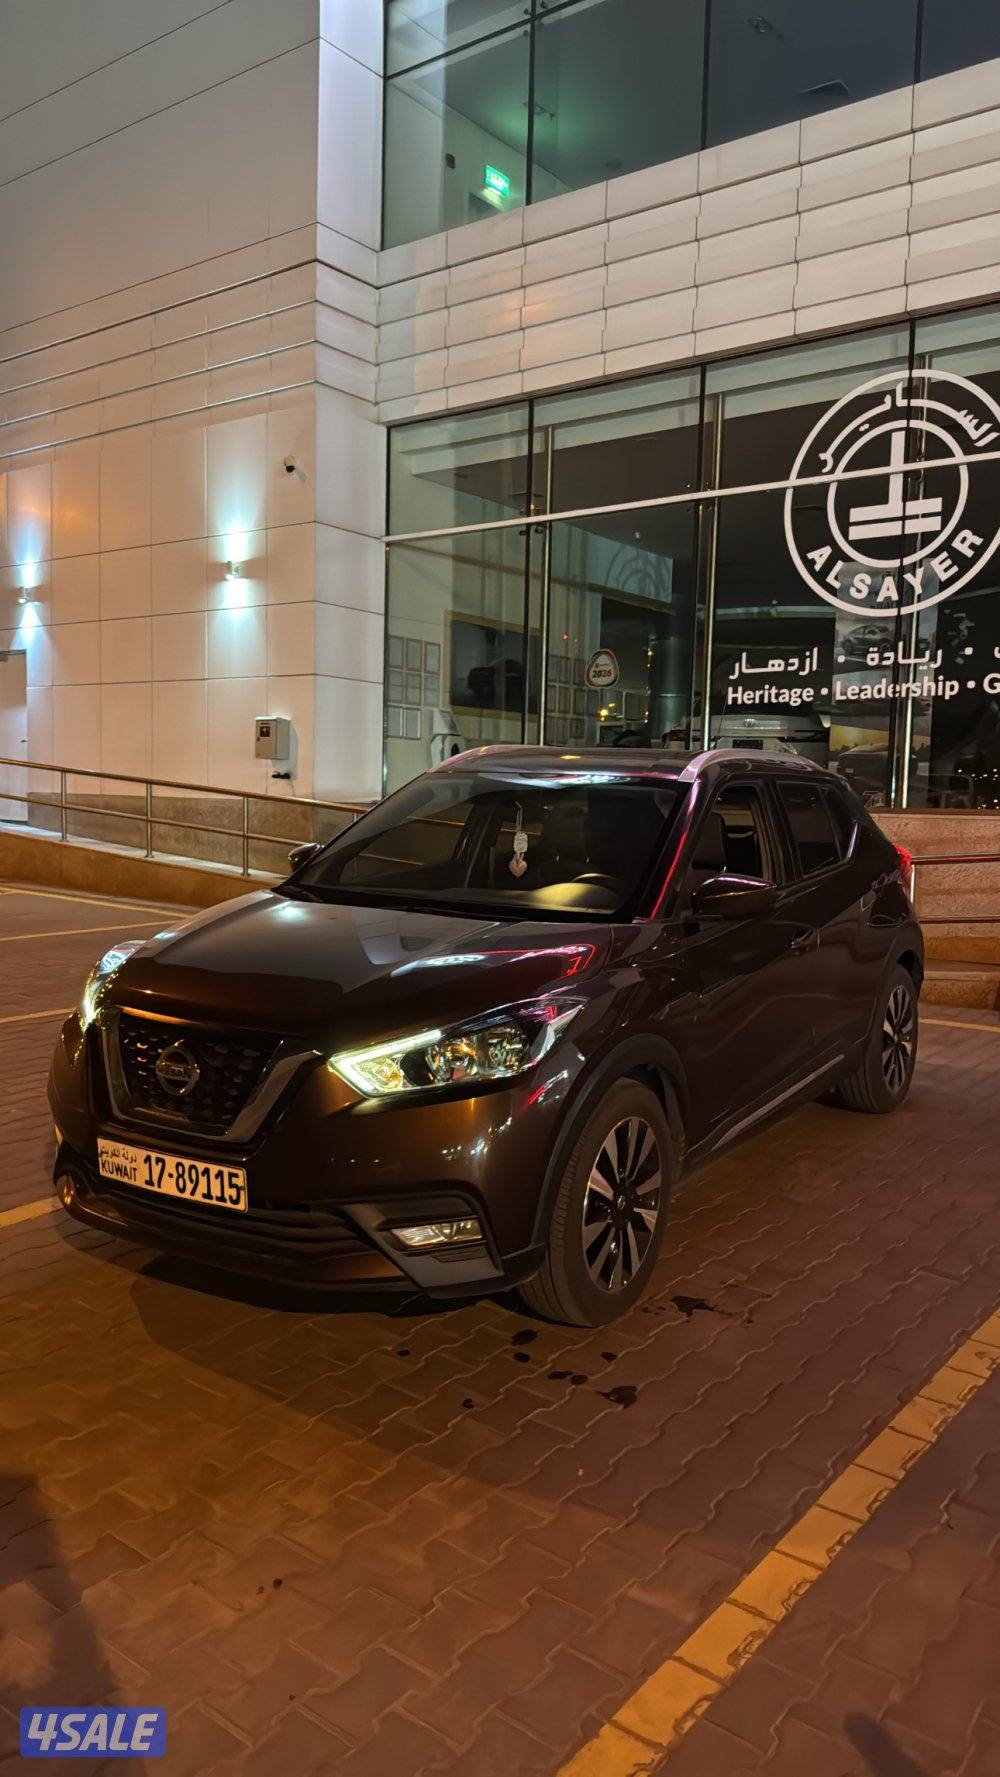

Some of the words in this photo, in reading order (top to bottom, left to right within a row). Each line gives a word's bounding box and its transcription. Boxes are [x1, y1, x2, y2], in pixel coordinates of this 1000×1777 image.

[806, 528, 984, 602] ALSAYER
[592, 669, 612, 679] 2026
[727, 684, 815, 706] Heritage
[835, 675, 959, 700] Leadership
[100, 1159, 138, 1182] KUWAIT
[143, 1154, 241, 1206] 17-89115
